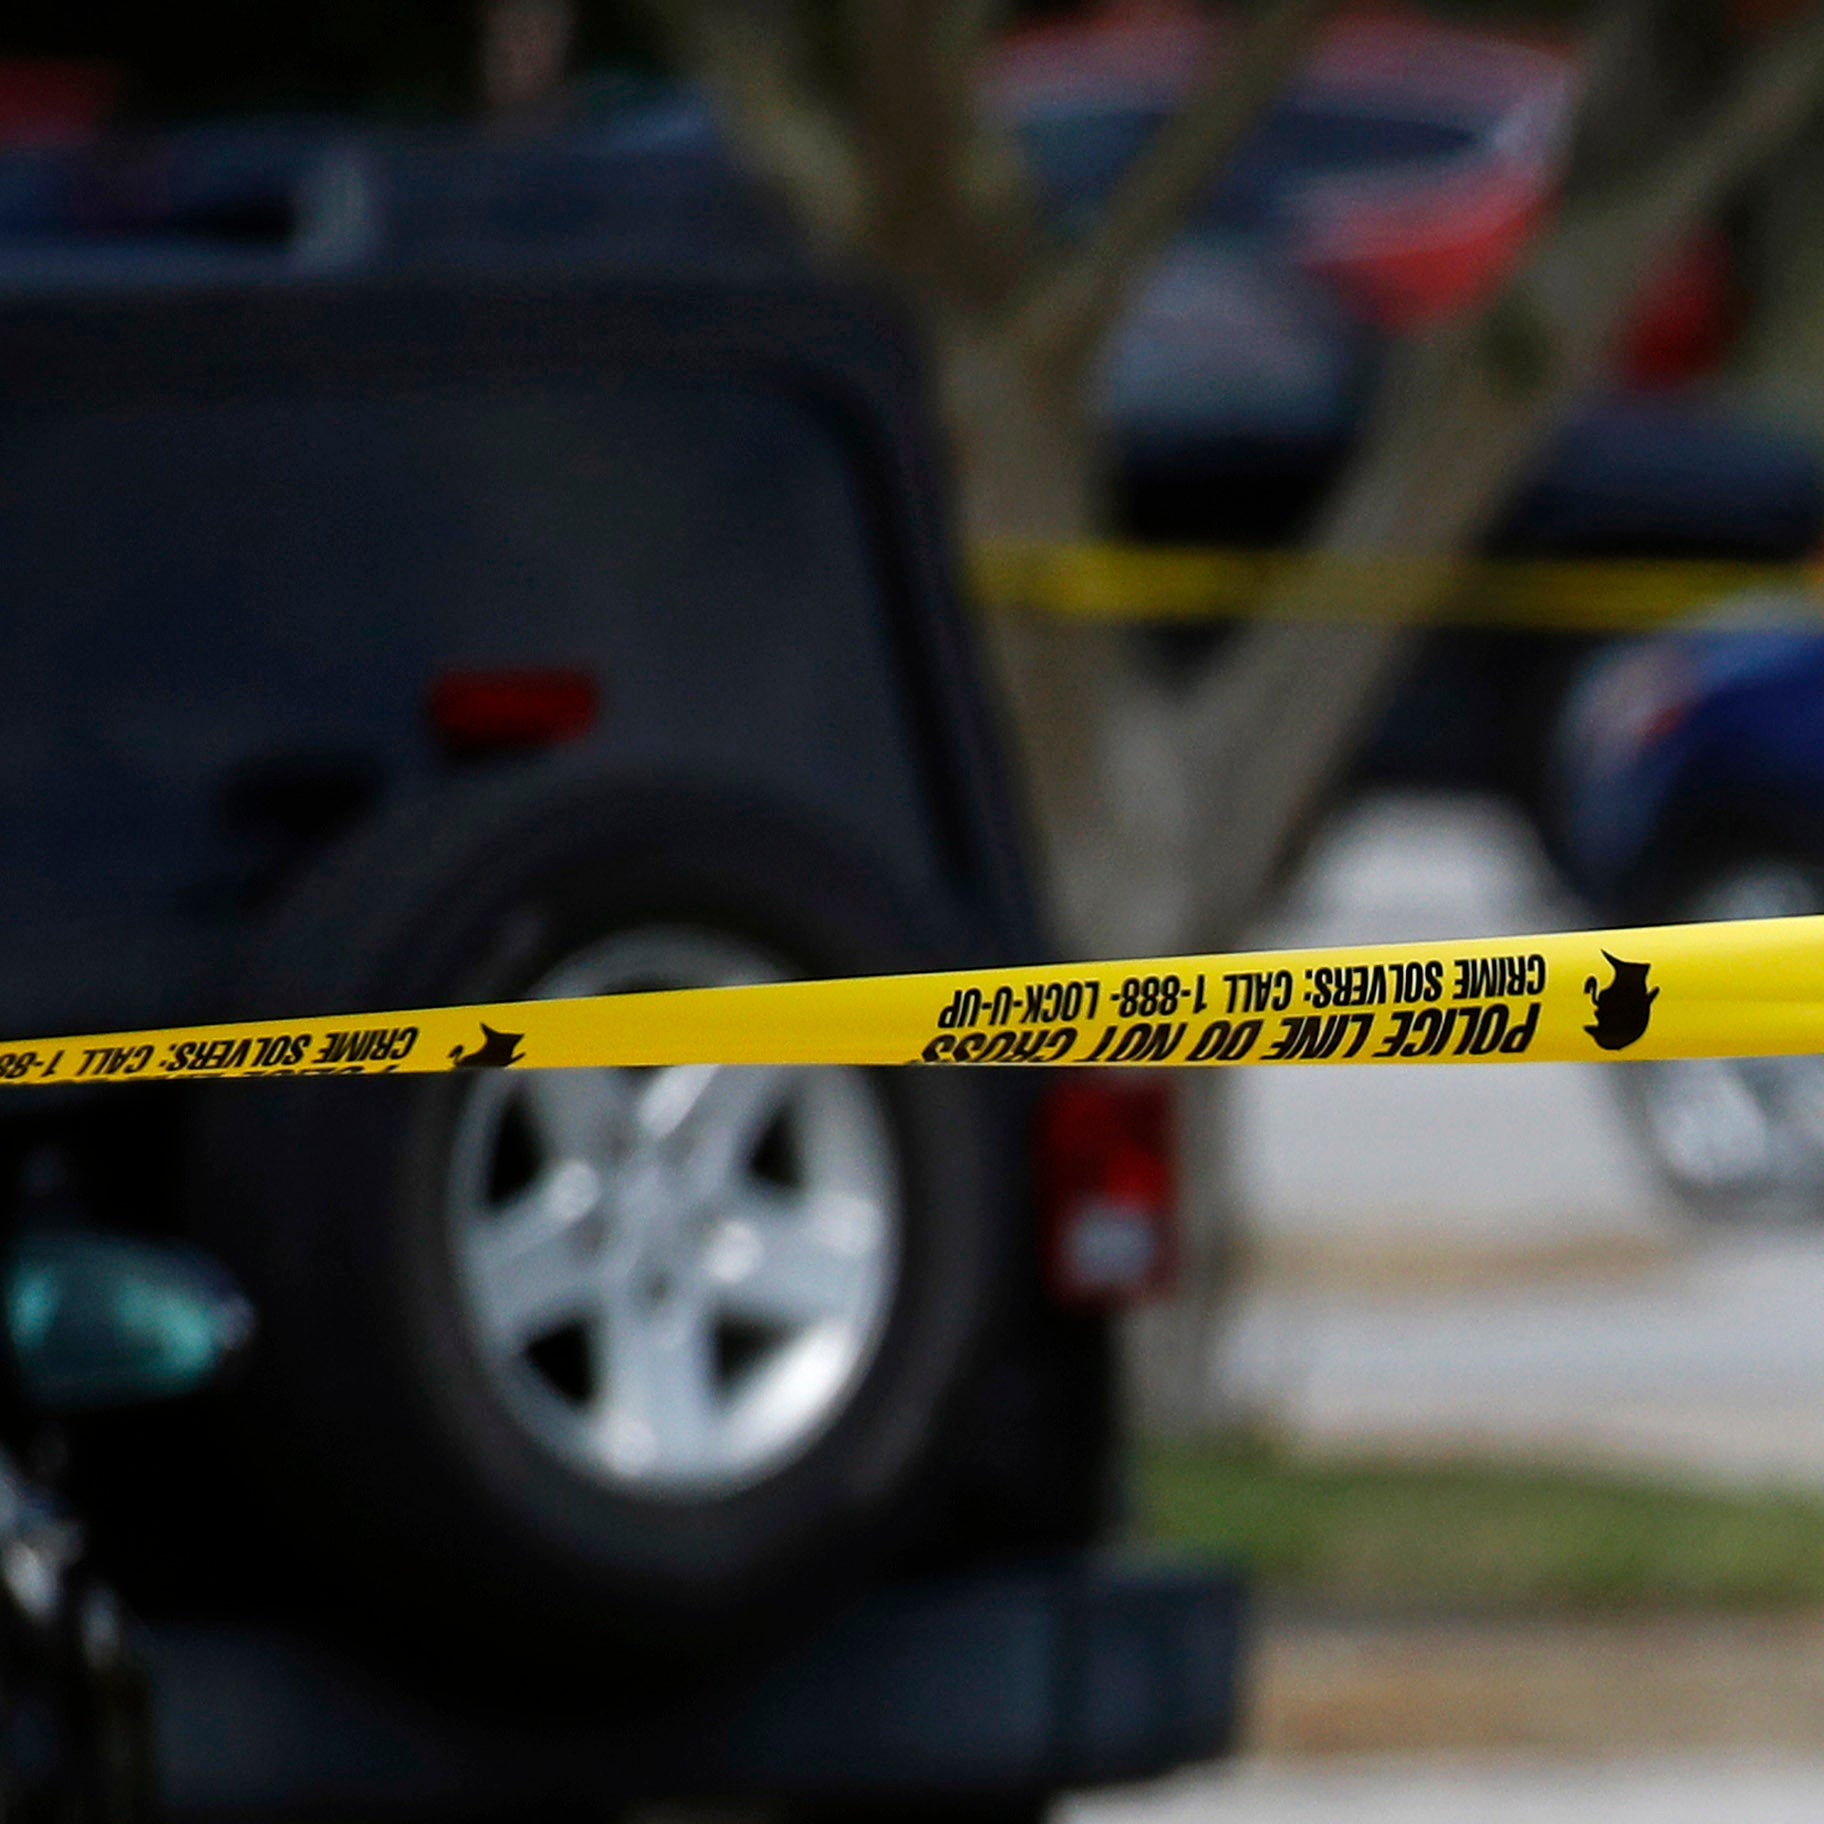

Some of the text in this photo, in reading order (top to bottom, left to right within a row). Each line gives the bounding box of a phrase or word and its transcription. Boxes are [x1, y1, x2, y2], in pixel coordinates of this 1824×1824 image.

[1223, 970, 1293, 1014] CALL
[1303, 960, 1444, 1009] SOLVERS:
[1452, 954, 1546, 1001] CRIME
[310, 1026, 419, 1064] CRIME
[1074, 1022, 1188, 1063] NOT
[1185, 1019, 1264, 1062] DO
[1259, 1012, 1375, 1061] LINE
[1371, 1002, 1542, 1058] POLICE
[75, 1044, 155, 1076] CALL
[157, 1033, 313, 1072] SOLVERS:
